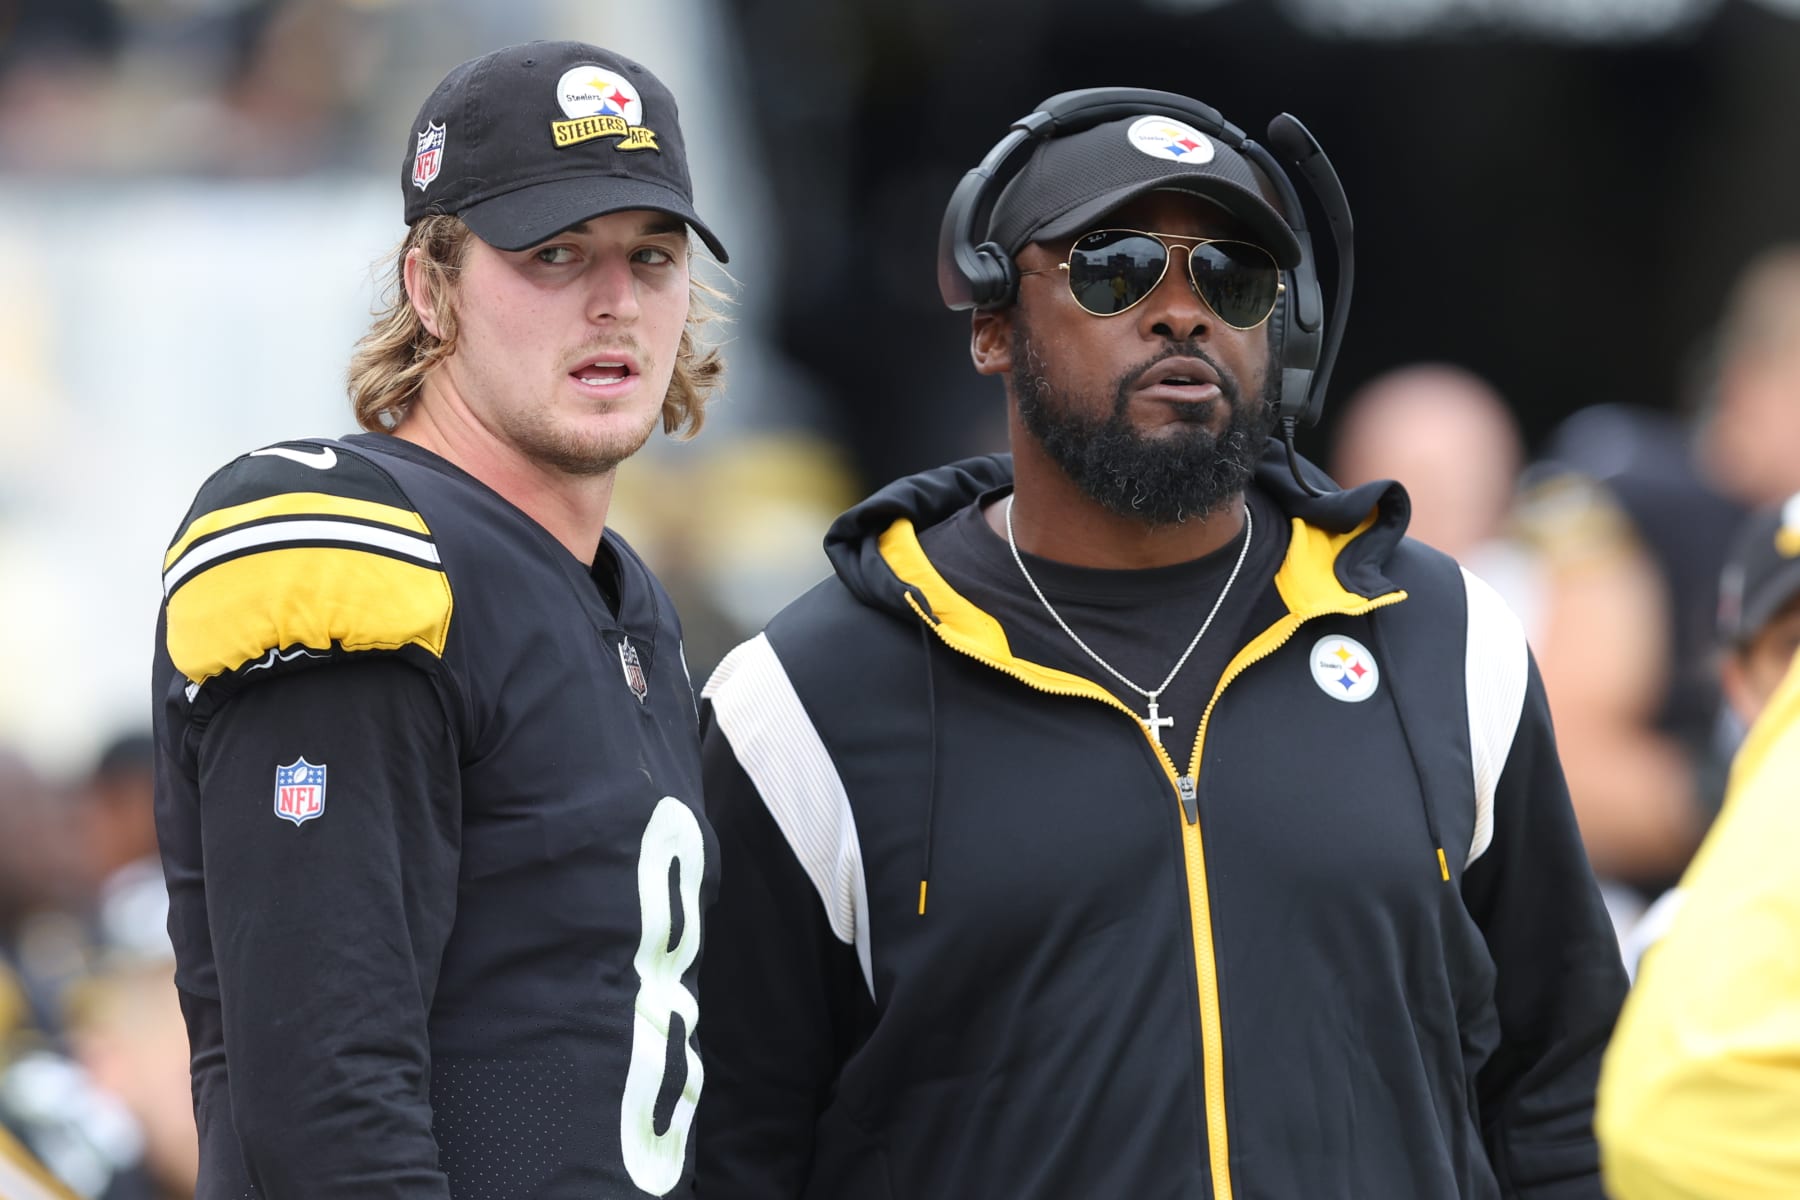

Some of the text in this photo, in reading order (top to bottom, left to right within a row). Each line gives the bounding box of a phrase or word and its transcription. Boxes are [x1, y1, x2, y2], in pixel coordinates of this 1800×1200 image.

[566, 93, 601, 102] Steelers
[556, 118, 624, 142] STEELERS
[631, 129, 651, 144] AFC
[415, 151, 437, 180] NFL
[280, 787, 319, 816] NFL
[620, 796, 705, 1198] 8
